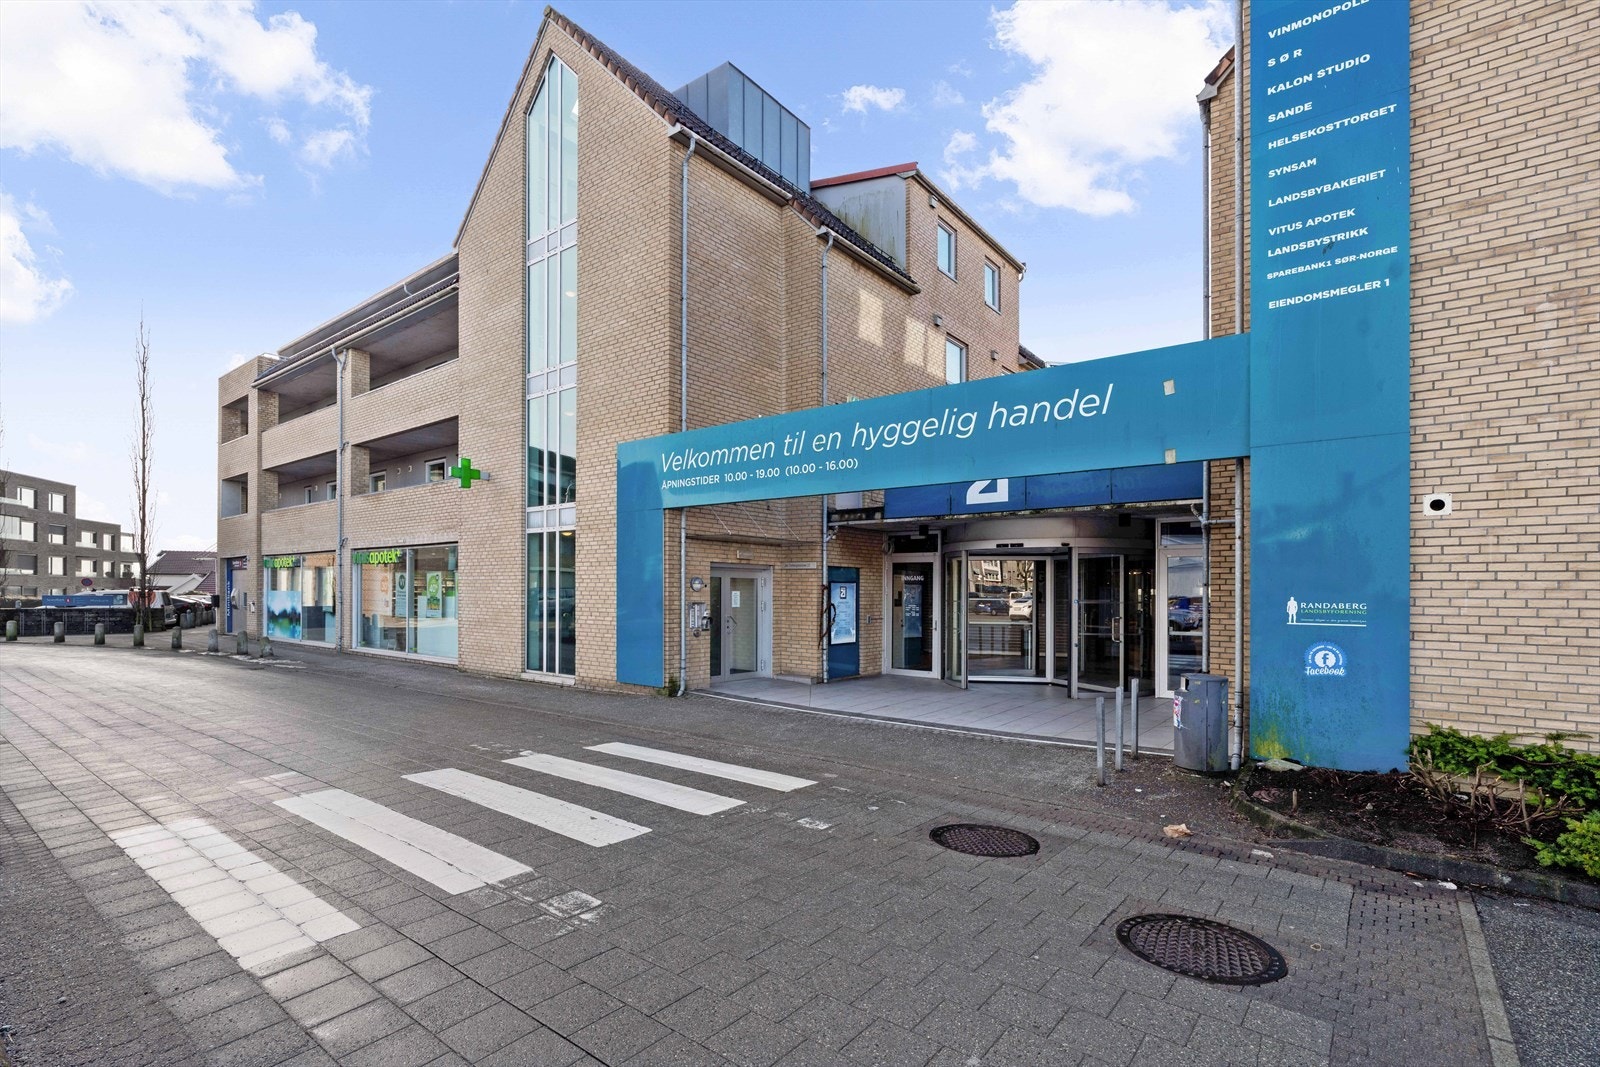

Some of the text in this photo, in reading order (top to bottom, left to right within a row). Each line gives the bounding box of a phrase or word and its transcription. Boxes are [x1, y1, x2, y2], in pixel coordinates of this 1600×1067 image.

[1267, 53, 1371, 96] KALON STUDIO
[1267, 101, 1313, 123] SANDE
[1267, 103, 1397, 150] HELSEKOSTTORGET
[1268, 157, 1317, 178] SYNSAM
[1268, 168, 1387, 208] LANDSBYBAKERIET
[1268, 207, 1356, 236] VITUS APOTEK
[1267, 226, 1369, 258] LANDSBYSTRIKK
[1266, 245, 1398, 280] SPAREBANK1 SØR-NORGE
[1268, 278, 1390, 310] EIENDOMSMEGLER 1
[661, 383, 1114, 475] Velkommen til en hyggelig handel
[661, 474, 720, 490] ÅPNINGSTIDER
[724, 471, 748, 483] 10.00
[755, 467, 781, 479] 19.00
[785, 462, 816, 477] (10.00
[825, 457, 859, 471] 16.00)
[1300, 602, 1367, 611] RANDABERG
[1300, 608, 1367, 616] LANDSBYFORENING
